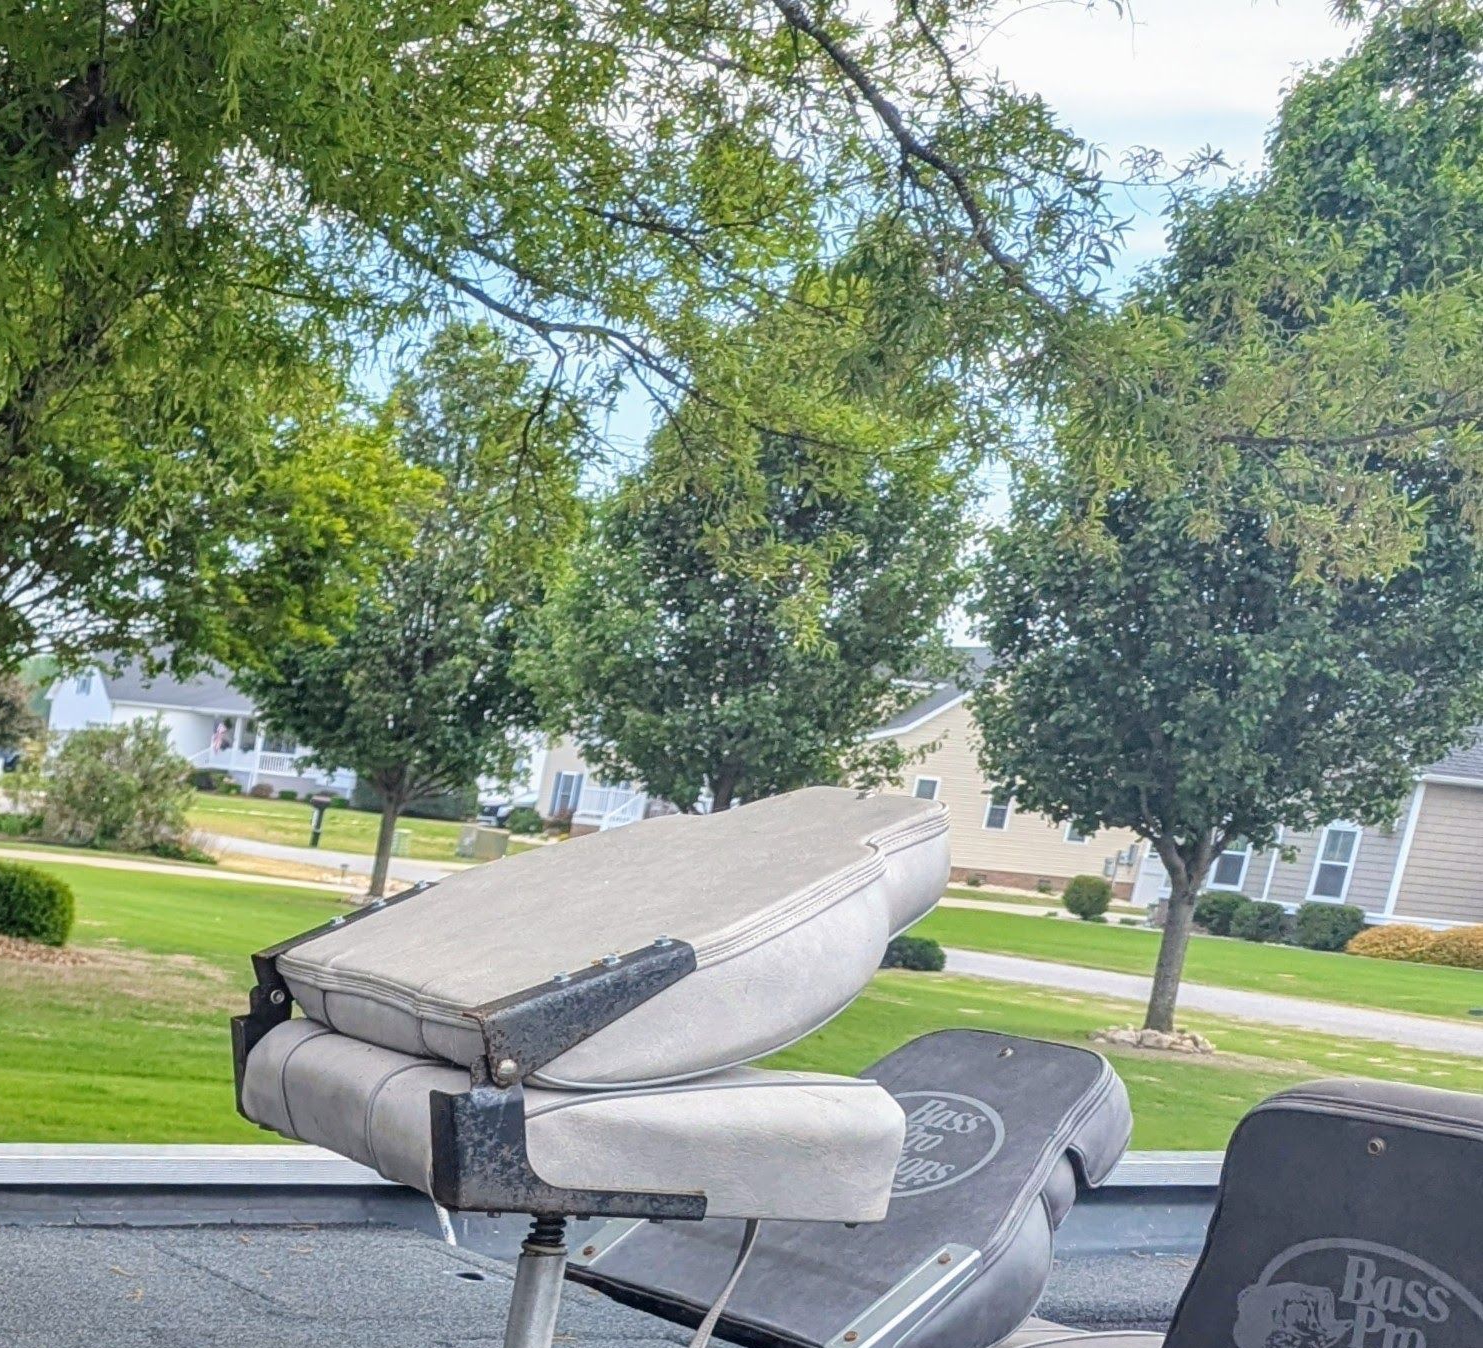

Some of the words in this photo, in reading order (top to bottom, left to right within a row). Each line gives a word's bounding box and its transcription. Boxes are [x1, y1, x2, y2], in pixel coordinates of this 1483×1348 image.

[907, 1099, 986, 1133] Bass
[893, 1151, 955, 1184] ops
[1338, 1254, 1451, 1323] Bass
